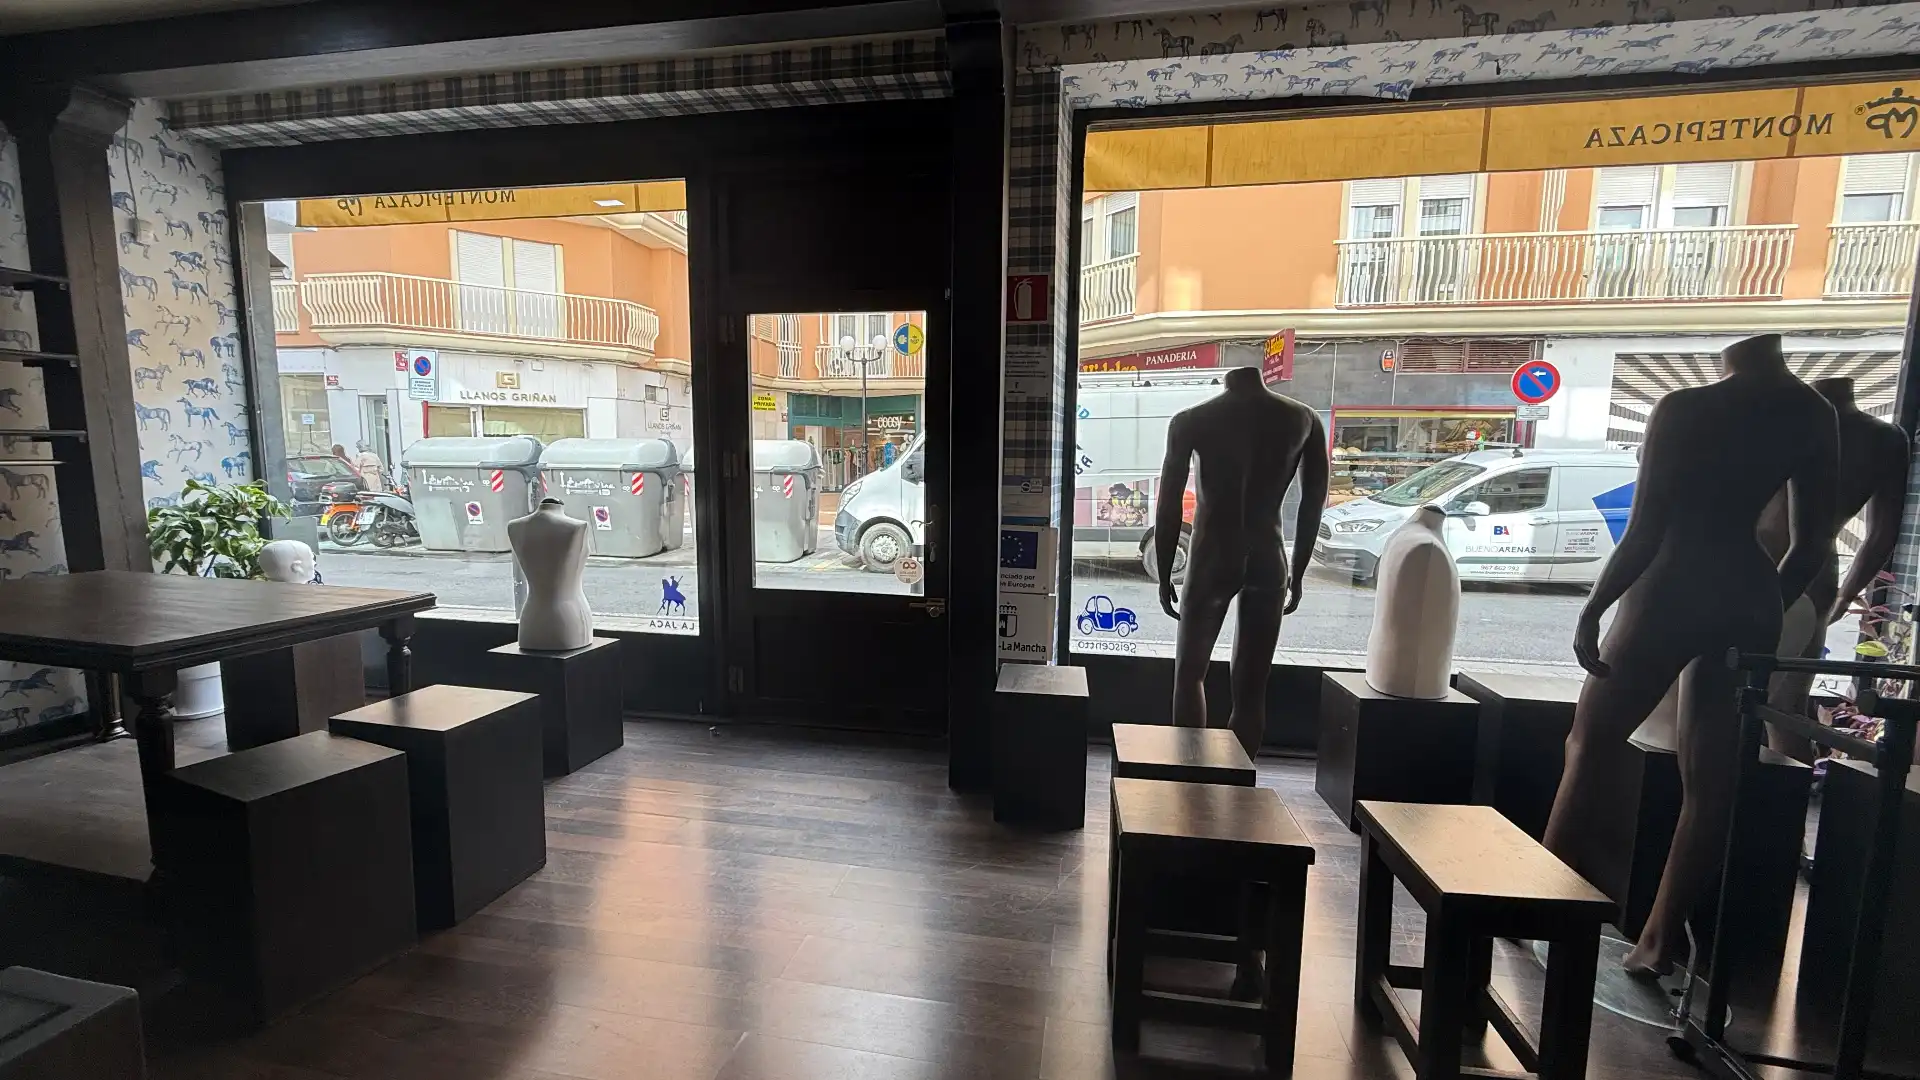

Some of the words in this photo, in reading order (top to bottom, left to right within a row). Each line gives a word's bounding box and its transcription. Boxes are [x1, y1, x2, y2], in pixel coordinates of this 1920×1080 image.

[1145, 350, 1197, 366] PANADERIA
[459, 390, 507, 401] LLANOS
[512, 392, 557, 403] GRIÑAN
[1465, 545, 1537, 554] BUENOARENAS
